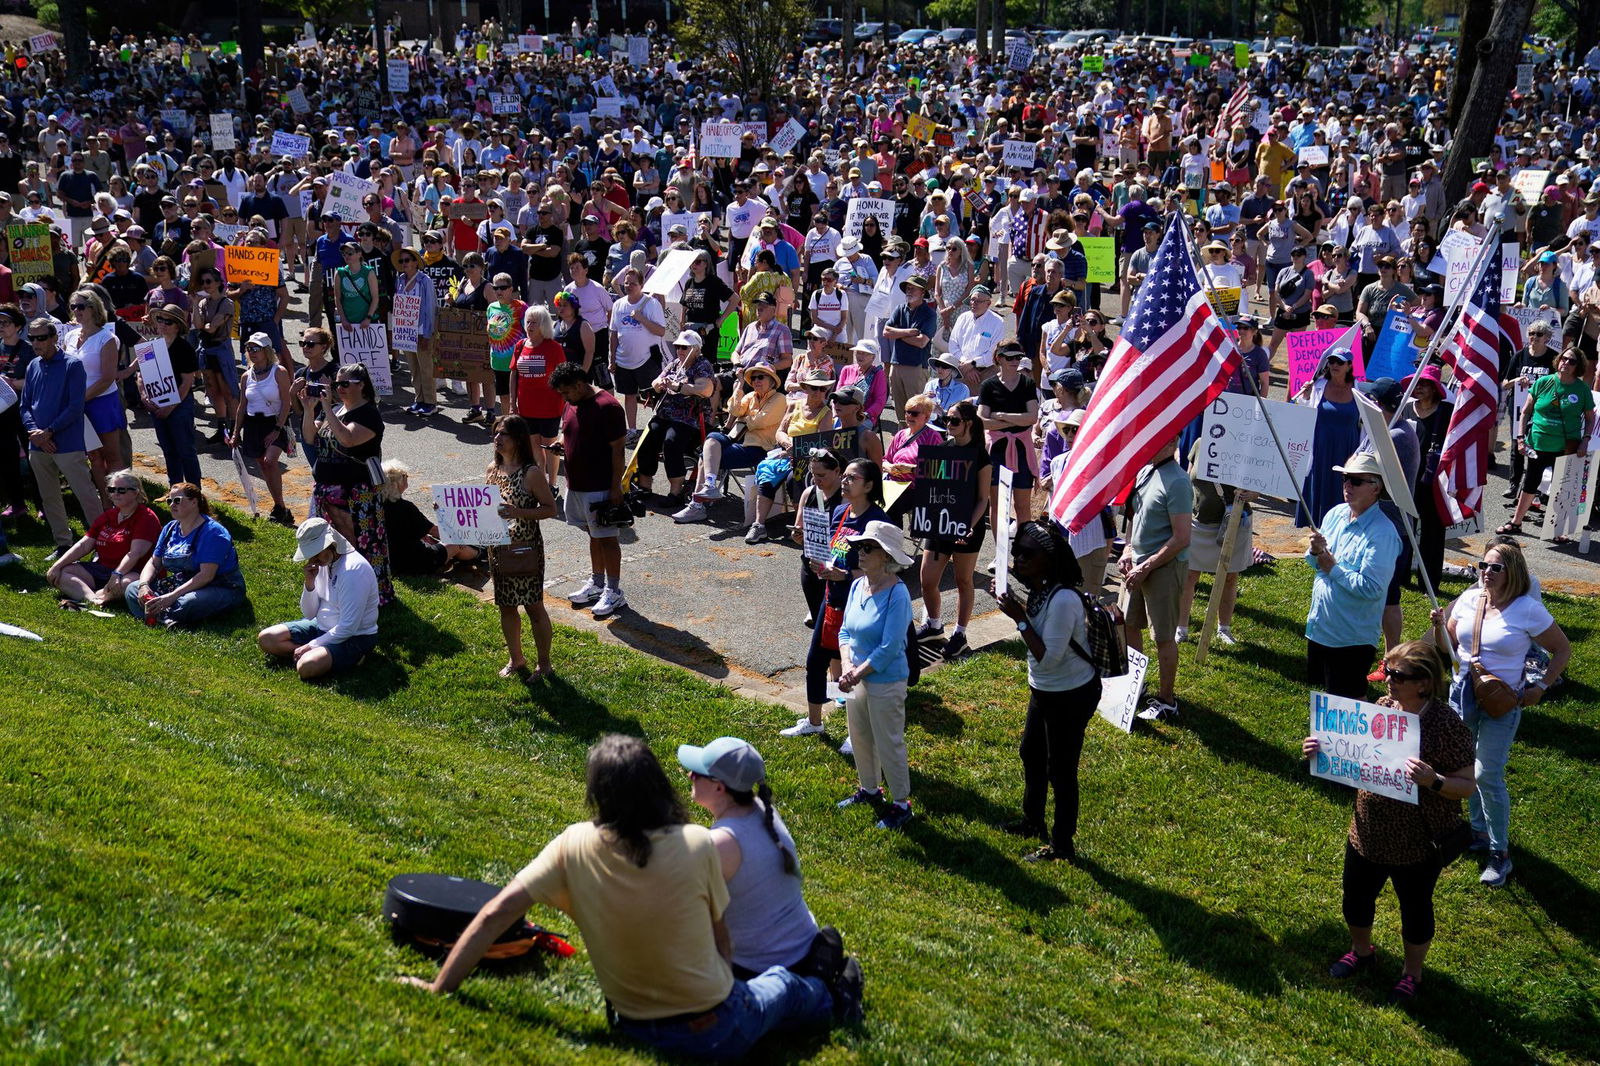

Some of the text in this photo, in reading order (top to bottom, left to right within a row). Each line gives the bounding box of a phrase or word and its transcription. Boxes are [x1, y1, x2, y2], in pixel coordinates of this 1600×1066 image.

[704, 143, 732, 155] HISTORY
[333, 171, 374, 192] HANDS OFF
[331, 201, 361, 219] PUBLIC
[856, 200, 884, 211] HONK!
[228, 247, 276, 263] HANDS OFF
[228, 264, 270, 282] Democracy
[405, 296, 420, 305] YOU
[340, 325, 385, 350] HANDS
[1290, 331, 1335, 348] DEFEND
[343, 350, 381, 366] OFF
[145, 376, 176, 400] RESIST
[794, 430, 857, 457] Hands OFF
[1287, 440, 1308, 452] isn't
[1208, 442, 1277, 471] Government
[917, 459, 973, 481] EQUALITY
[444, 486, 492, 508] HANDS
[929, 487, 957, 505] Hurts
[456, 509, 479, 529] OFF
[913, 507, 967, 536] No One
[806, 530, 828, 546] OFF!
[1371, 712, 1408, 743] OFF
[1315, 750, 1416, 796] DEMOCRACY
